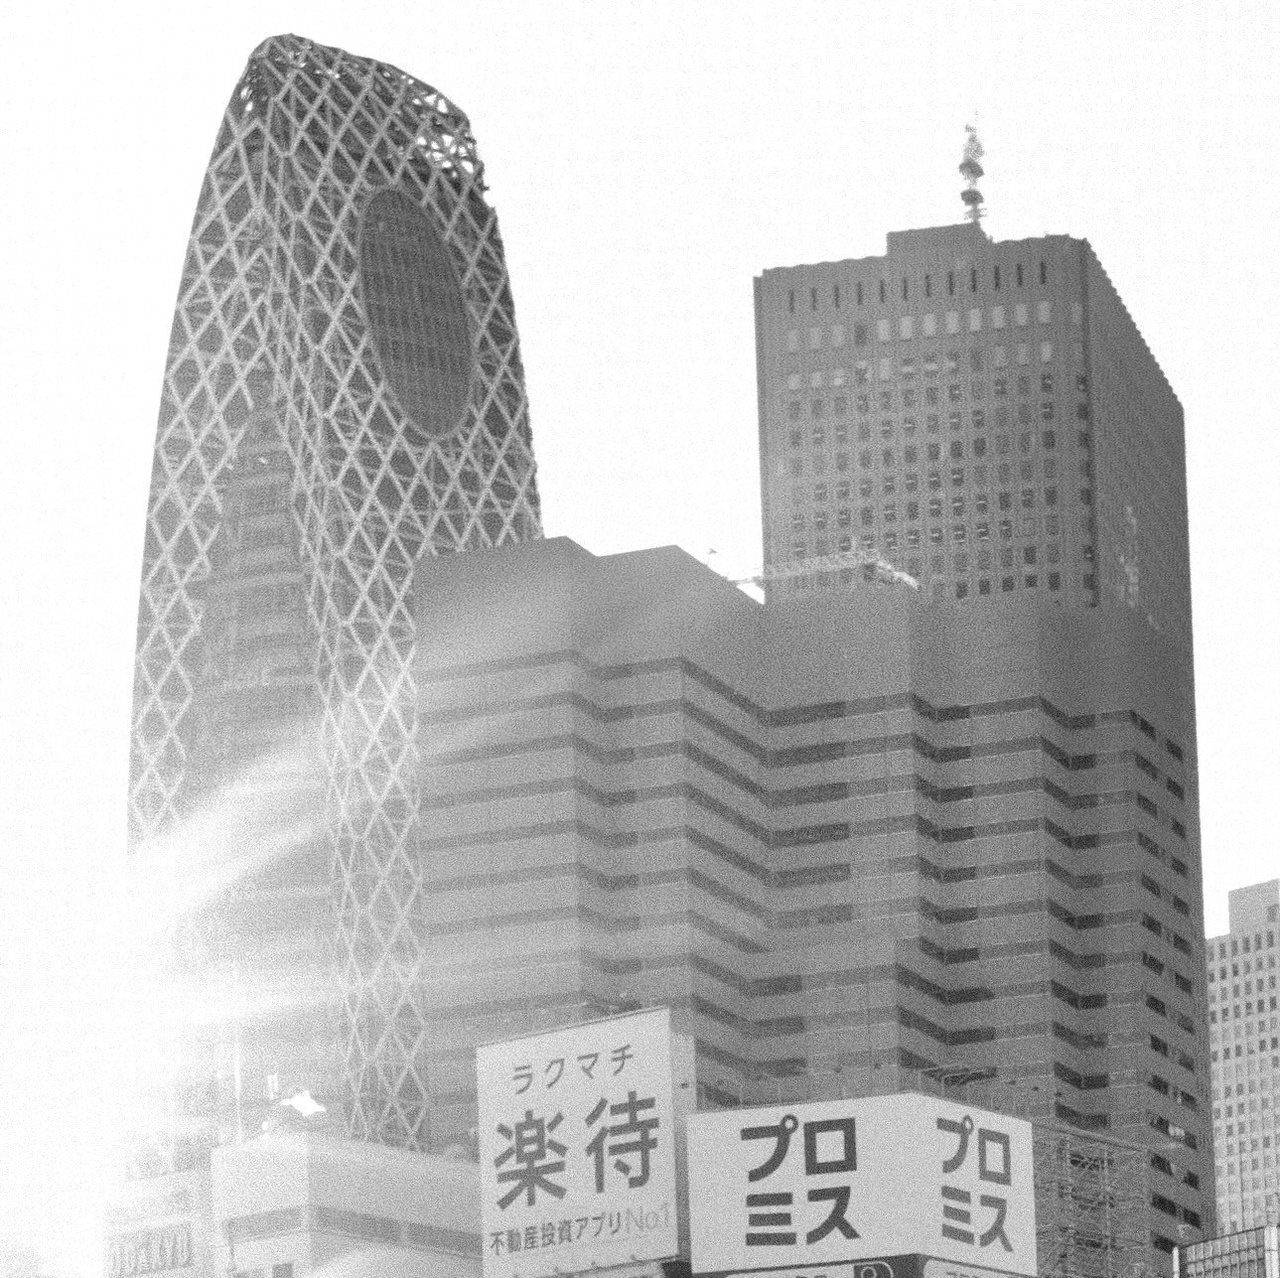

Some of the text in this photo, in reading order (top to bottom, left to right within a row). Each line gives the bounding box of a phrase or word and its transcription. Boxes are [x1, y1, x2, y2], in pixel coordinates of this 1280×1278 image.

[511, 1044, 635, 1095] ラクマチ
[492, 1090, 661, 1209] 楽待
[740, 1114, 858, 1184] プロ
[936, 1115, 1013, 1187] プロ
[745, 1185, 862, 1248] ミス
[940, 1185, 1014, 1252] ミス
